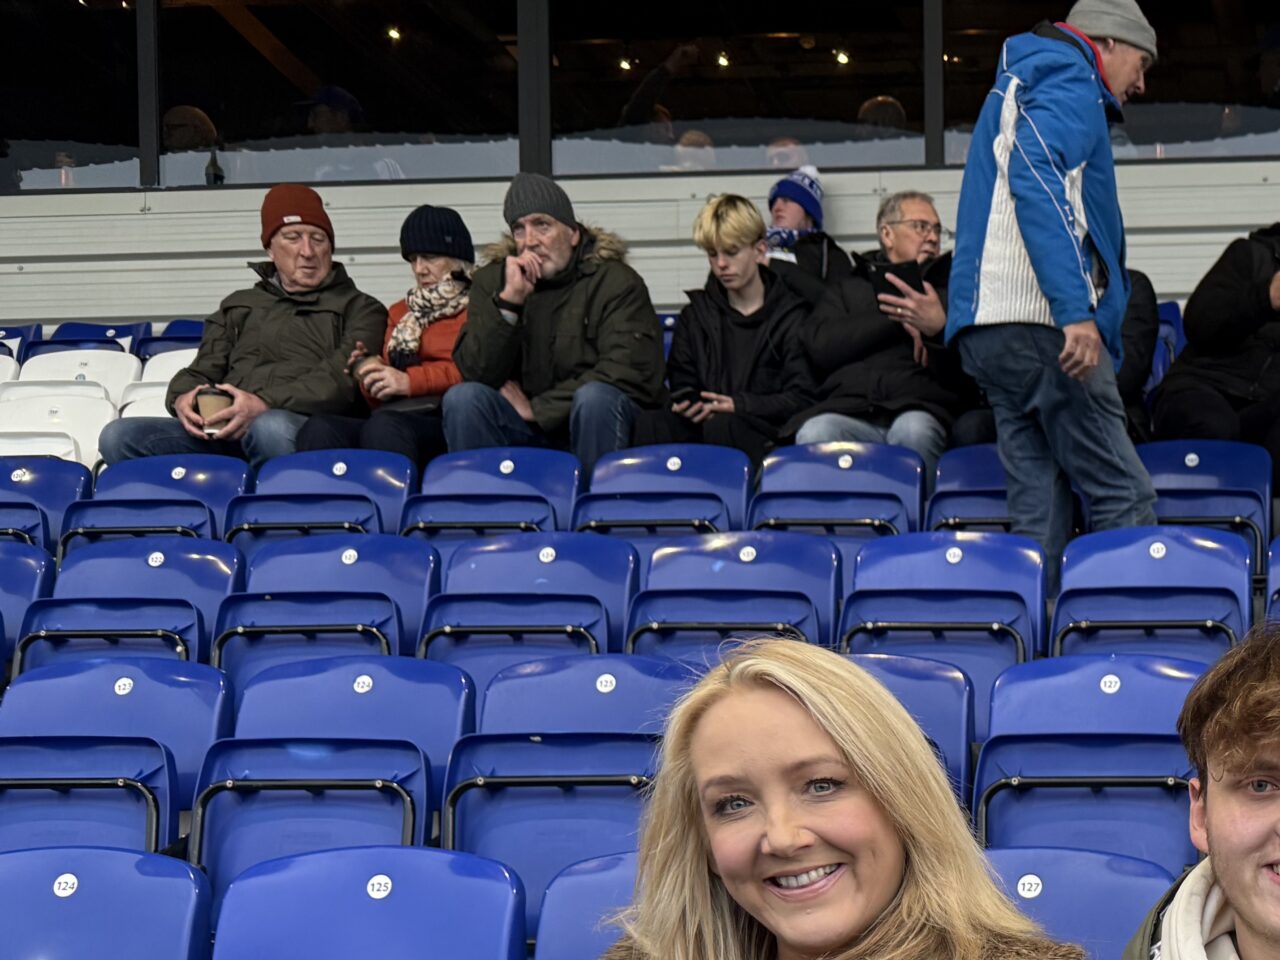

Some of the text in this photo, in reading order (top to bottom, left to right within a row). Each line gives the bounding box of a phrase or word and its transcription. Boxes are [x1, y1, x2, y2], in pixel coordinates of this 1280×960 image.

[357, 681, 371, 689] 124
[599, 681, 614, 689] 125
[1103, 681, 1118, 689] 127
[57, 882, 75, 891] 124
[371, 882, 390, 892] 125
[1021, 882, 1040, 892] 127
